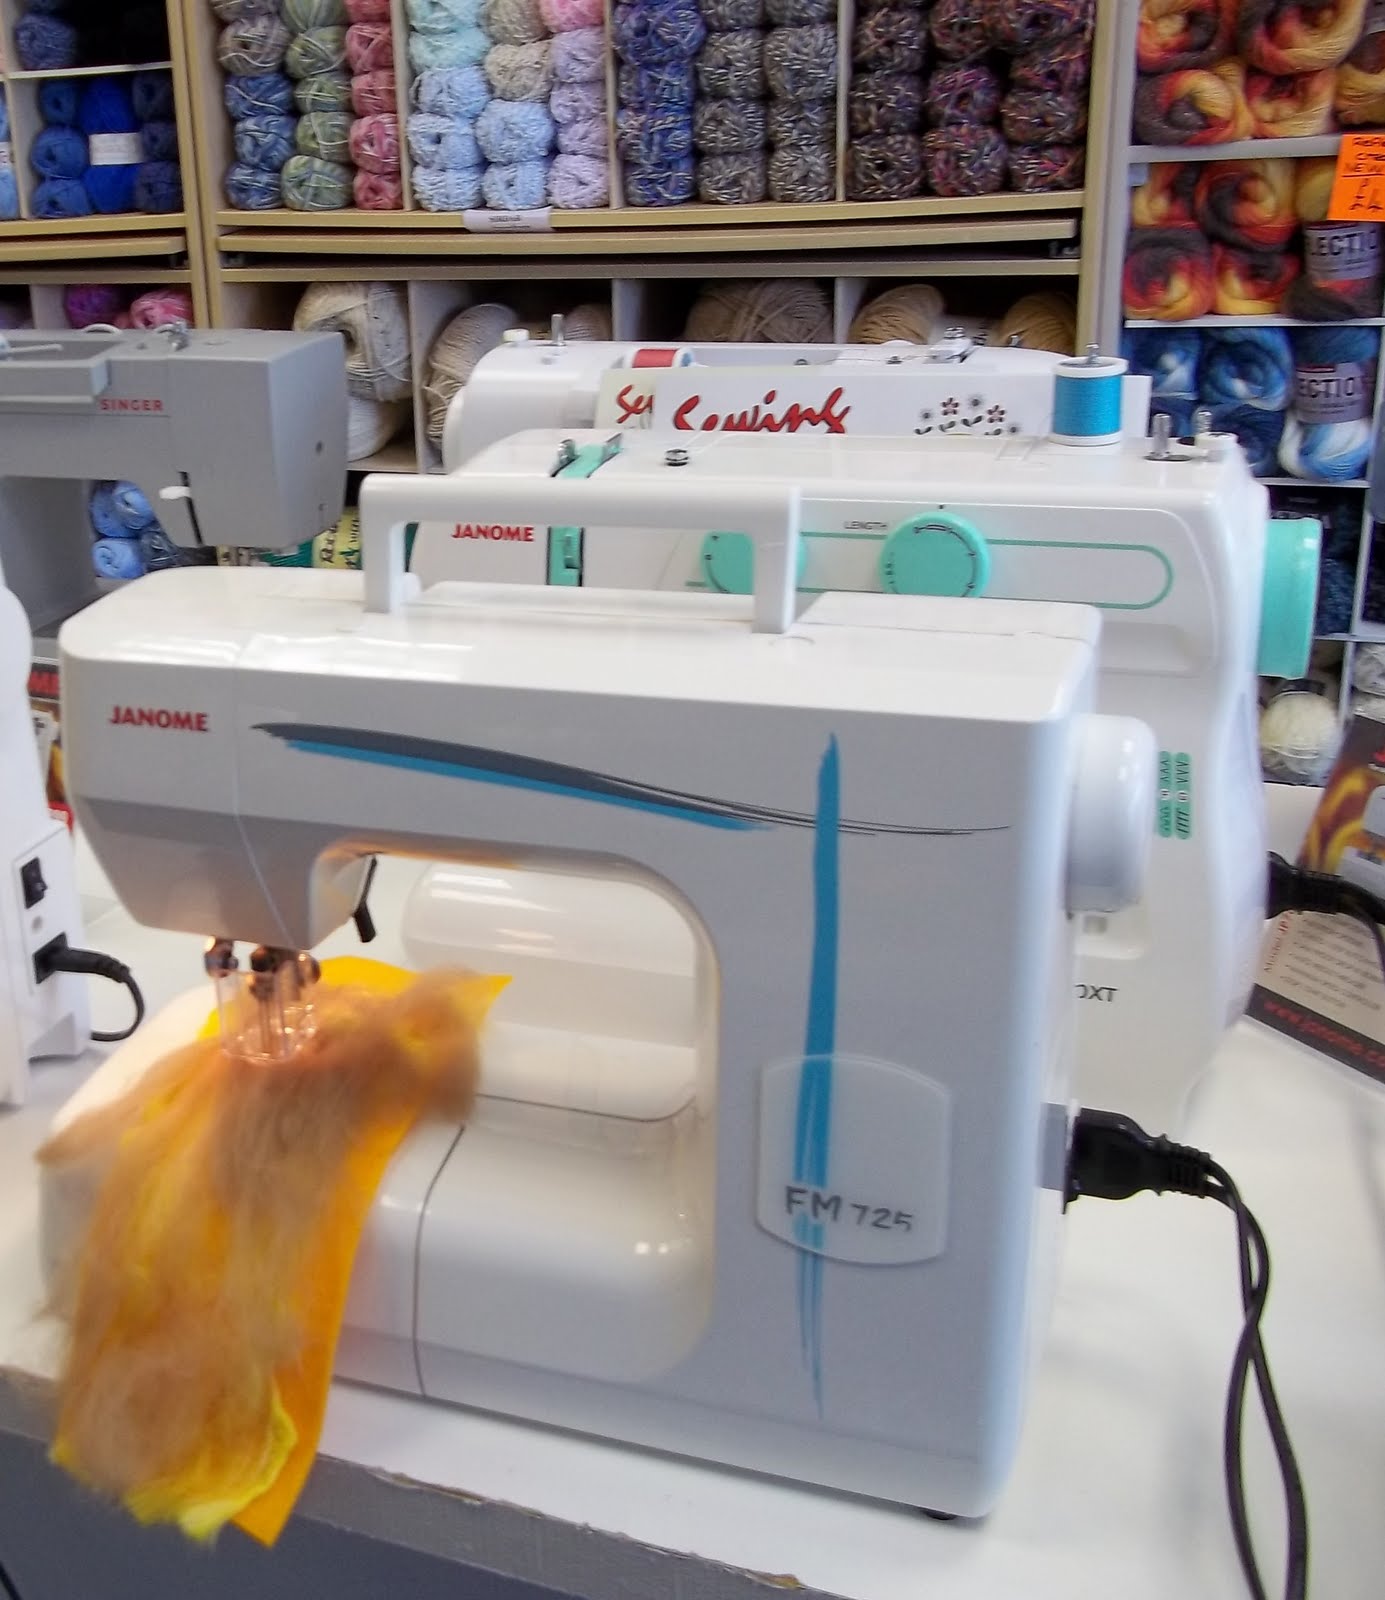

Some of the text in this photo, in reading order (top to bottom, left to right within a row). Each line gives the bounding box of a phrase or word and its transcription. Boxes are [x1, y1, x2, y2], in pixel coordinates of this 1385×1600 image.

[101, 399, 164, 412] SINGER
[452, 523, 535, 542] JANOME
[844, 520, 887, 531] LENGTH
[110, 705, 209, 733] JANOME
[785, 1185, 914, 1232] FM 725
